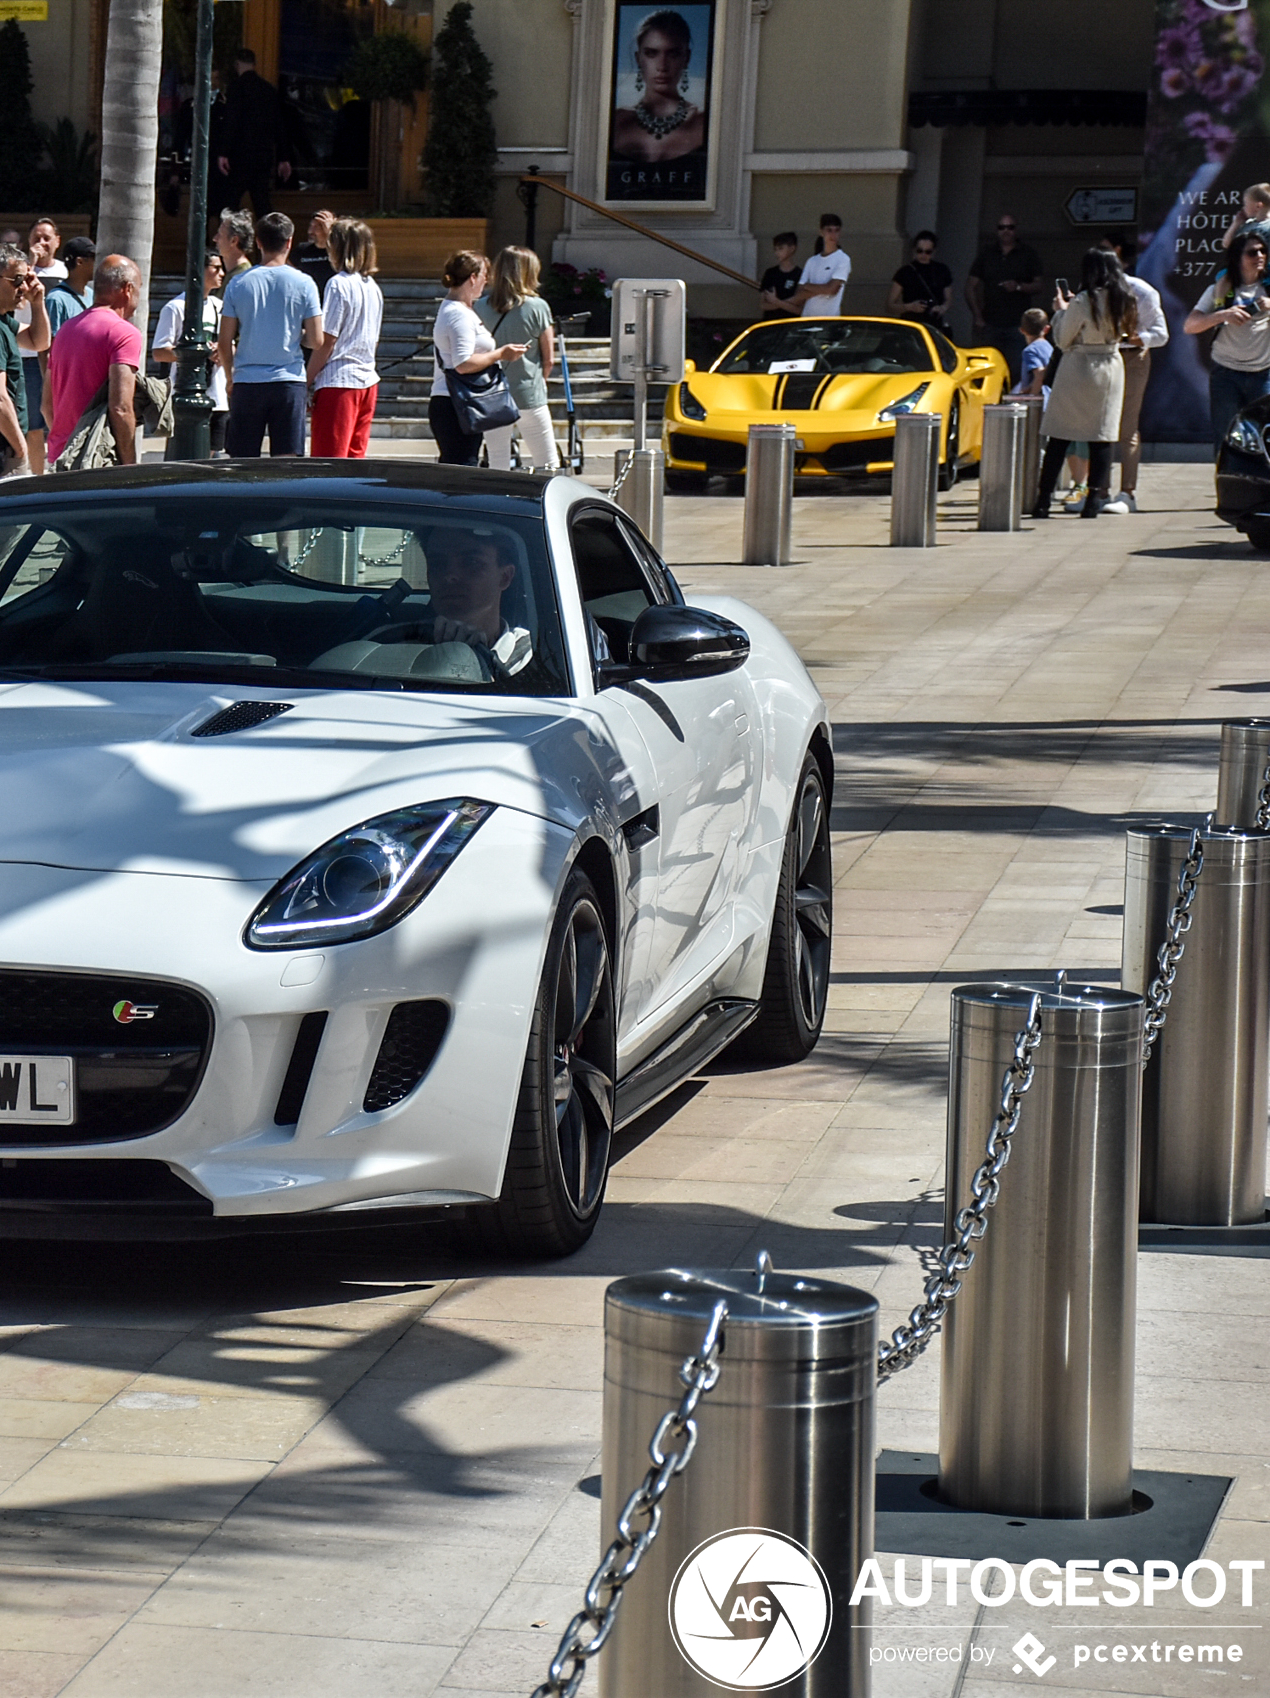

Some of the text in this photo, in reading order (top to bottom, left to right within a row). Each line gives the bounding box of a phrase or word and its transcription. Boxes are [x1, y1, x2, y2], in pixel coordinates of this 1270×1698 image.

[621, 171, 692, 183] GRAFF
[1178, 191, 1241, 205] WE AR
[1175, 238, 1224, 253] PLAC
[1173, 262, 1216, 277] +377
